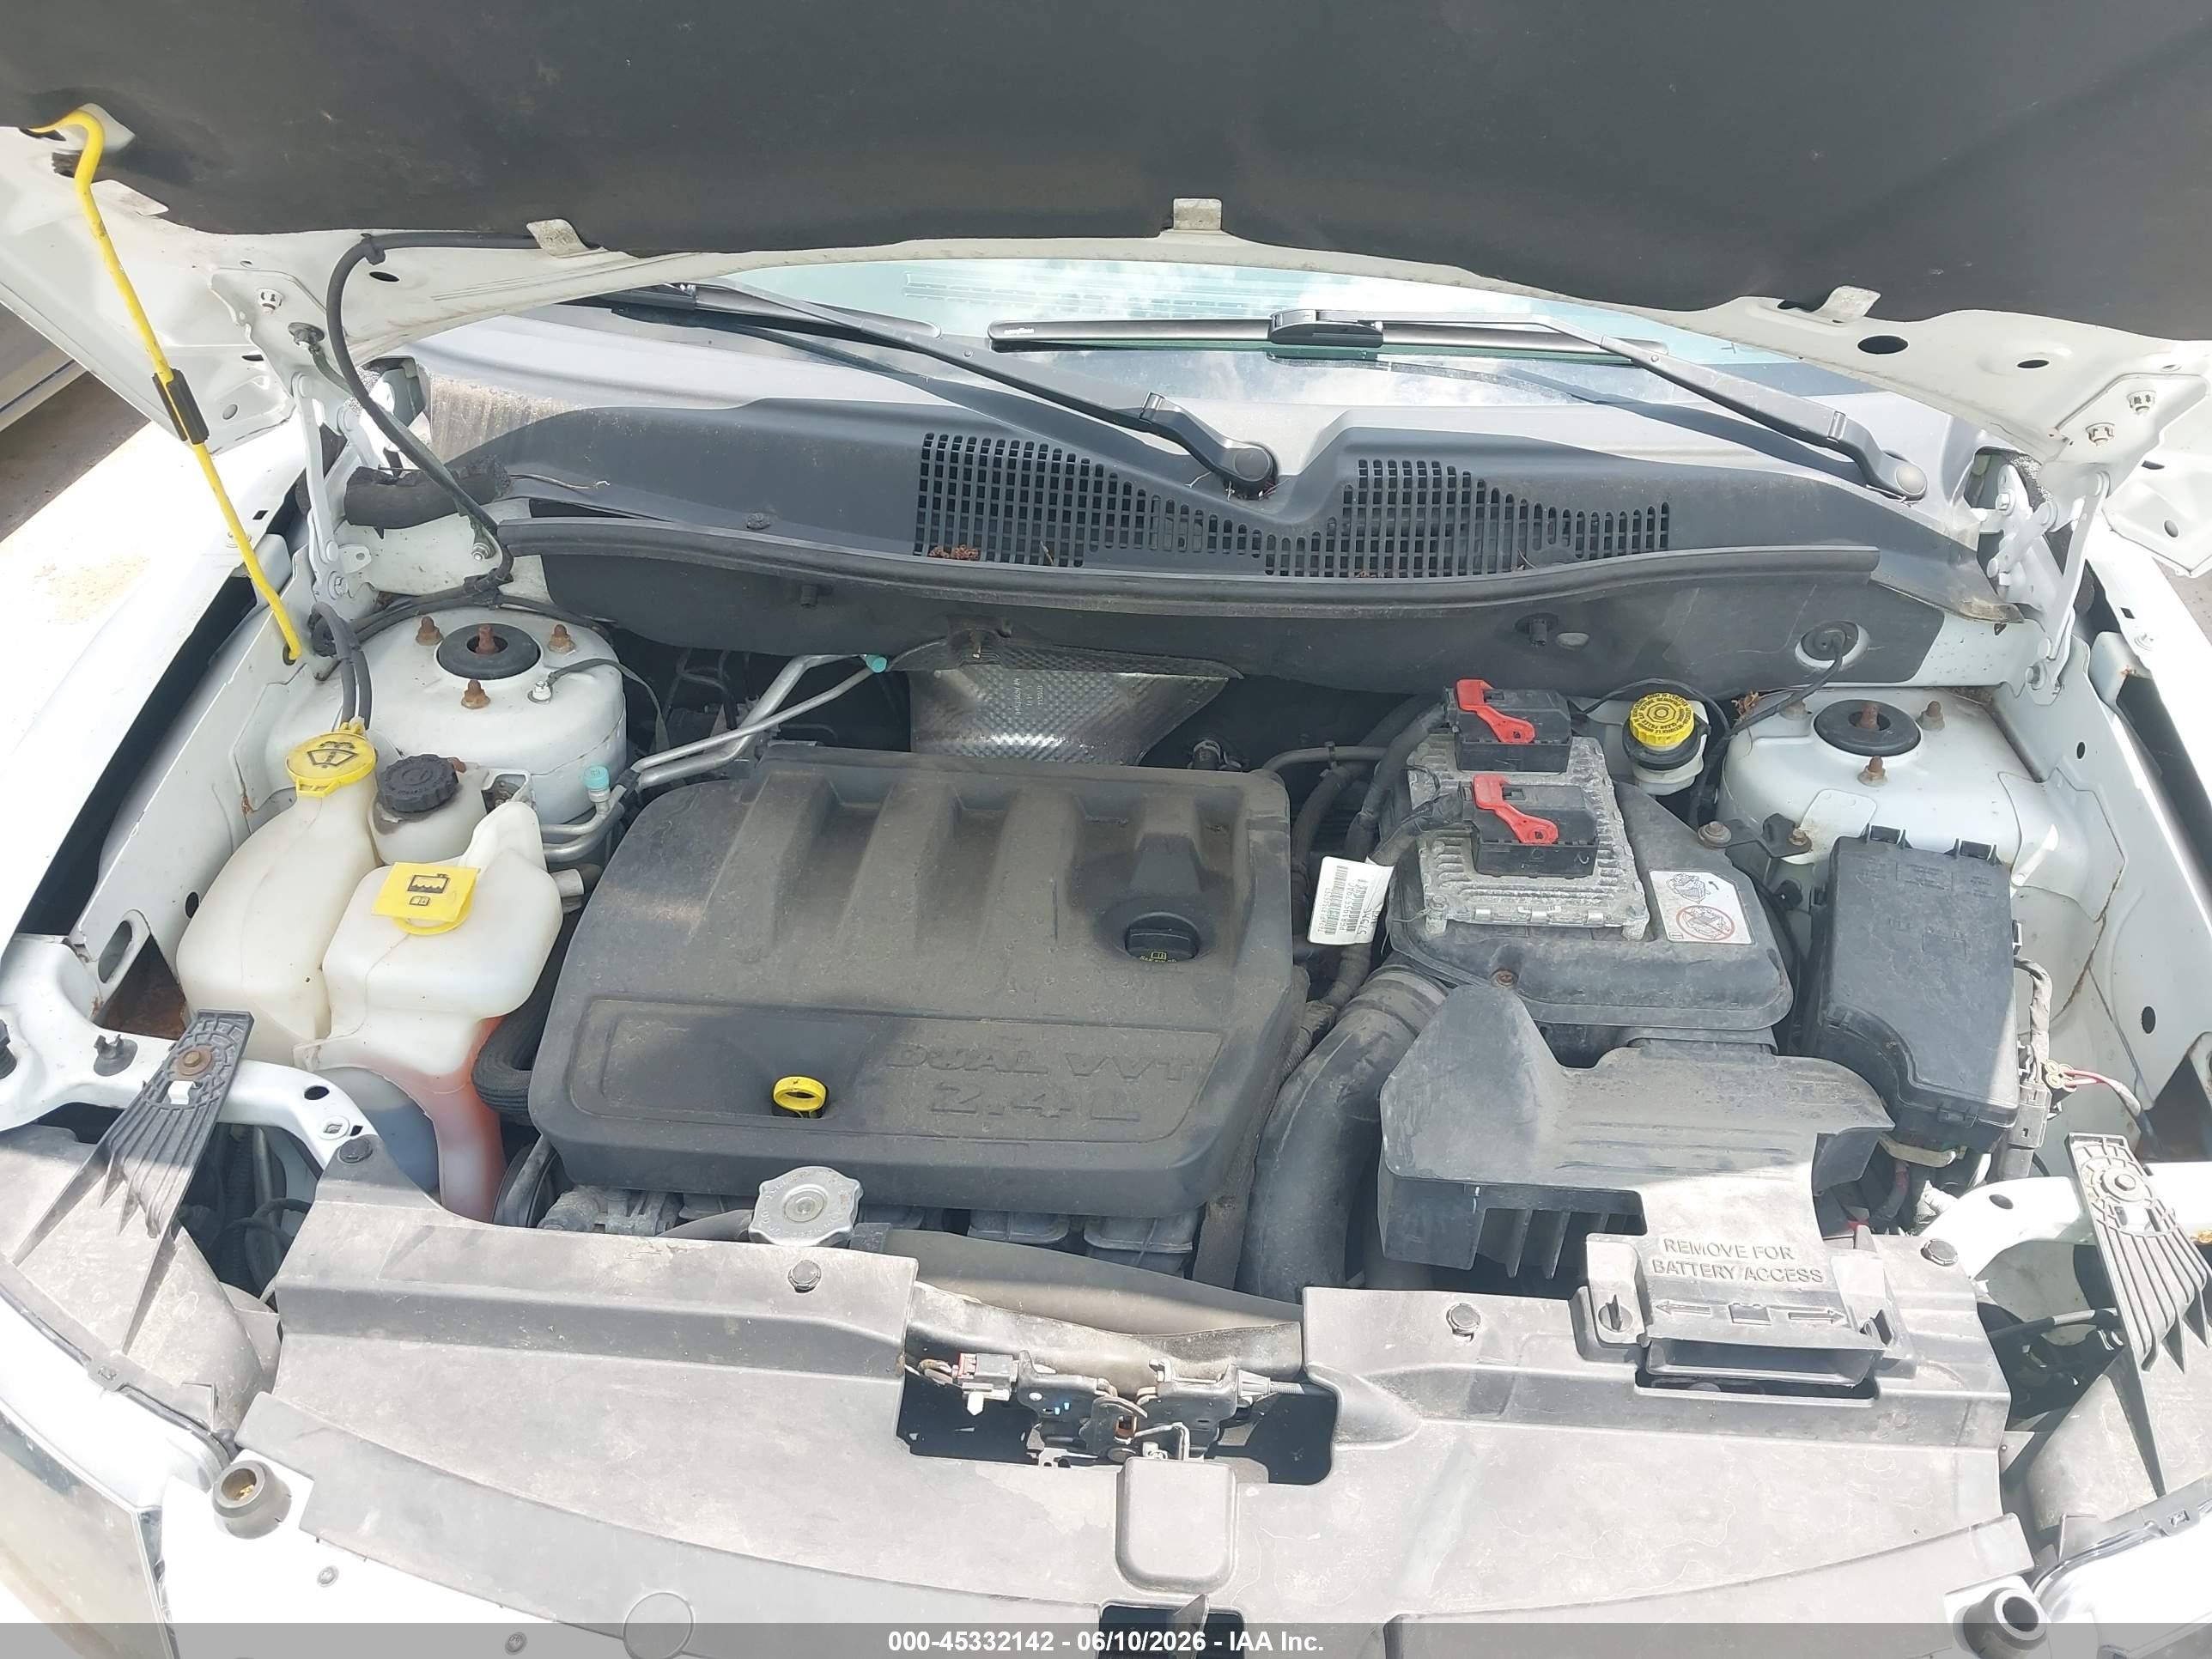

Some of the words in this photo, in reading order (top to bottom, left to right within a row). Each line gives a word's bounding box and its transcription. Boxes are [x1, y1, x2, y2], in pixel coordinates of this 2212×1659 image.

[884, 1043, 1050, 1075] DUAL
[1064, 1052, 1194, 1083] VVT
[1662, 1237, 1748, 1260] REMOVE
[1753, 1245, 1796, 1261] FOR
[1651, 1259, 1735, 1280] BATTERY
[1744, 1267, 1824, 1283] ACCESS
